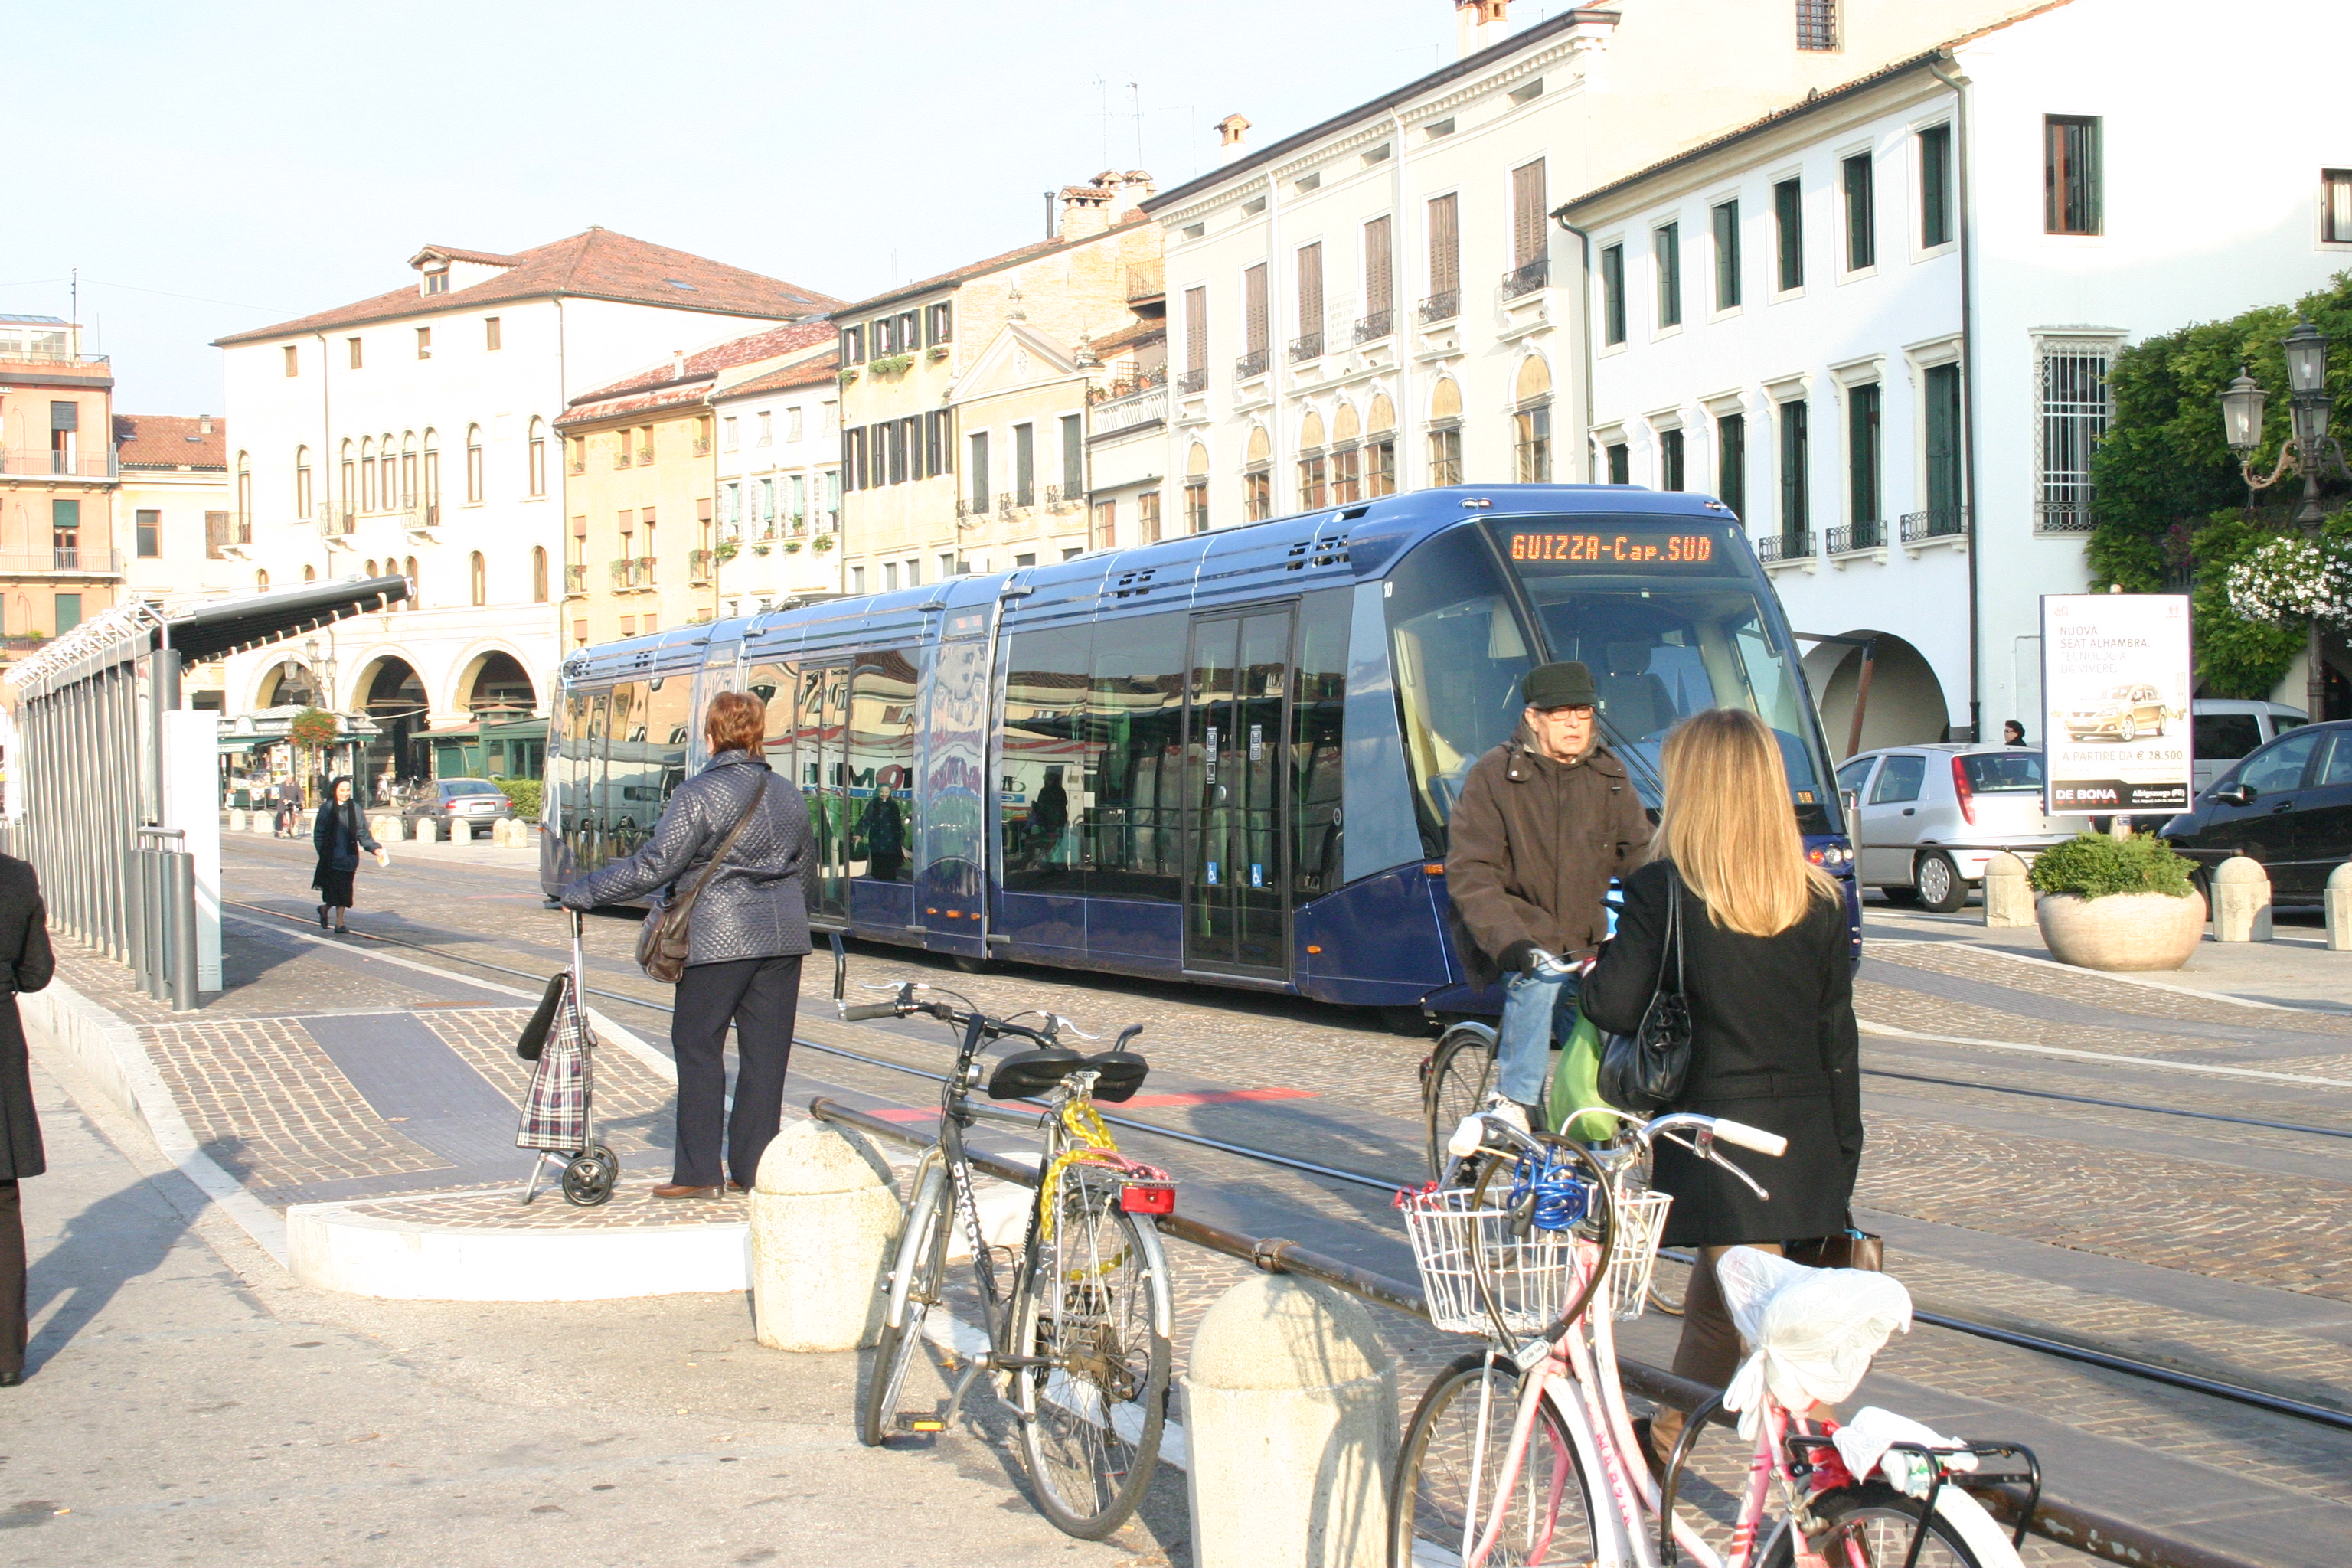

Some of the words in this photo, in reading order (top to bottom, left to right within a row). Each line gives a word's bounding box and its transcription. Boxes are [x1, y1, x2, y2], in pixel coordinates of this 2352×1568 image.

[1383, 581, 1393, 598] 10
[2060, 626, 2099, 636] NUOVA
[2060, 639, 2086, 648] SEAT
[2089, 638, 2151, 648] ALHAMBRA.
[2061, 651, 2127, 662] TECNOLOGIA
[2060, 664, 2076, 674] DA
[2079, 663, 2118, 674] VIVERE.
[2062, 752, 2069, 762] A
[2073, 751, 2115, 762] PARTIRE
[2119, 751, 2133, 761] DA
[2136, 750, 2145, 760] €
[2148, 750, 2183, 760] 28.500
[2056, 789, 2074, 800] DE
[2076, 789, 2117, 800] BONA
